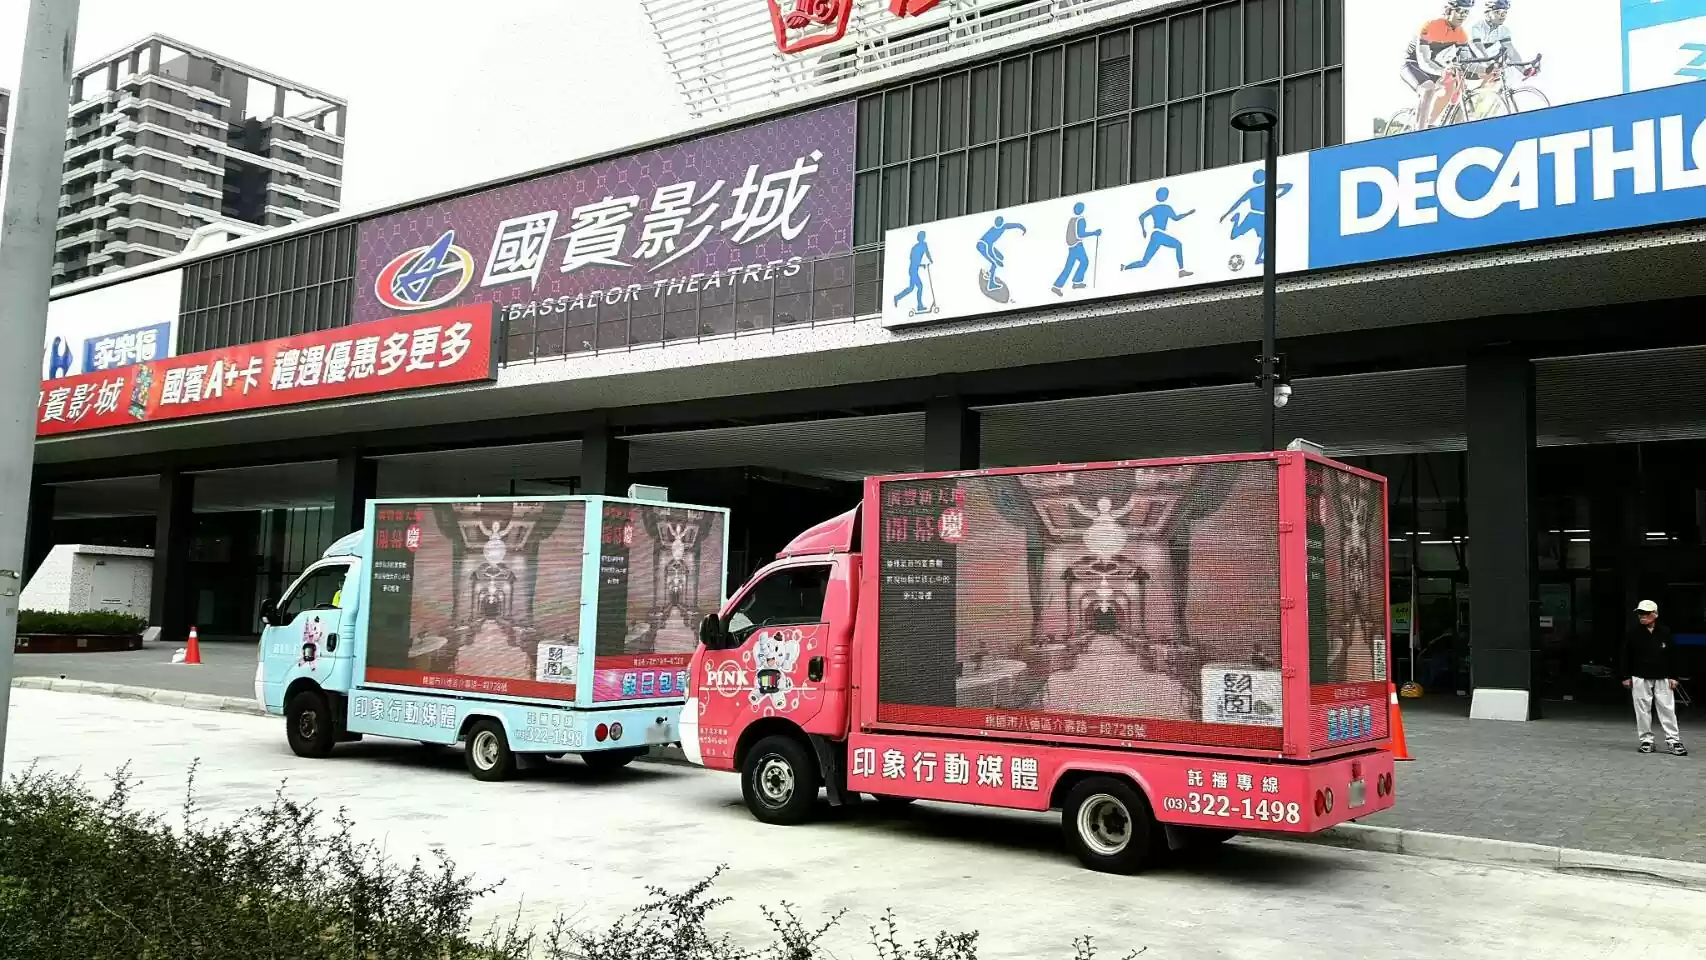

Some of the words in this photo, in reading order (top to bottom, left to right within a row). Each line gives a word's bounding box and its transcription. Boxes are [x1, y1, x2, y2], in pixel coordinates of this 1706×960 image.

[1340, 114, 1706, 237] DECATHL
[480, 148, 824, 290] 國賓影城
[500, 283, 641, 322] BASSADOR
[653, 256, 803, 298] THEATRES
[160, 357, 261, 406] 國賓A+卡
[270, 320, 473, 392] 禮遇優惠多更多
[38, 377, 124, 424] 賓影城
[706, 670, 750, 686] PINK
[353, 695, 457, 730] 印象行動媒體
[852, 748, 1039, 791] 印象行動媒體
[1187, 769, 1279, 793] 託播專線
[1163, 792, 1301, 824] (03)322-1498
